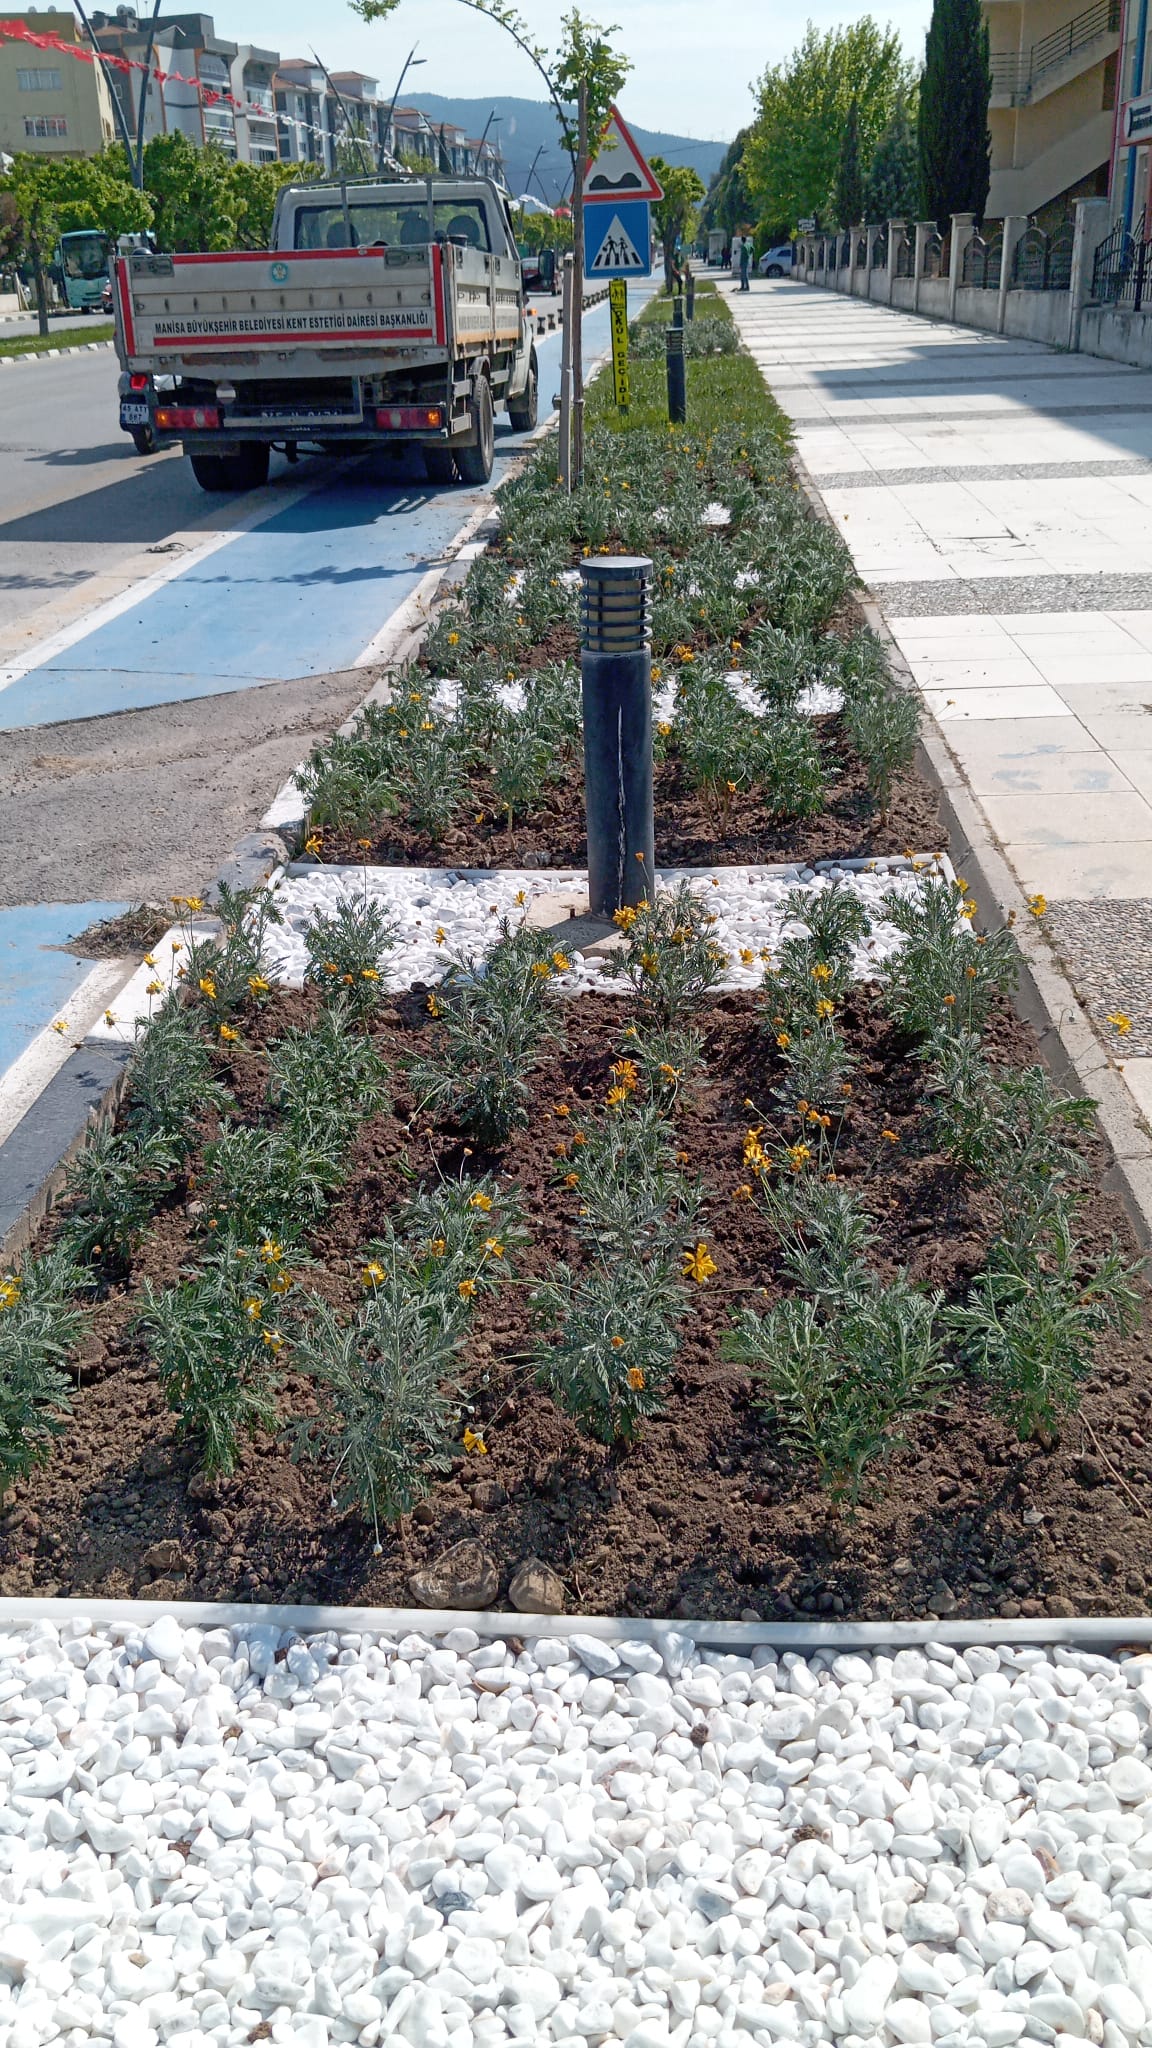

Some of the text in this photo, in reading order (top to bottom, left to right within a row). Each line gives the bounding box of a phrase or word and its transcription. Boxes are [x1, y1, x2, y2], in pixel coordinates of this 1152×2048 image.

[155, 319, 186, 334] MANİSA
[187, 317, 238, 335] BÜYÜKŞEHİR
[239, 315, 286, 331] BELEDİYESİ
[286, 317, 307, 329] KENT
[346, 311, 378, 327] DAİRESİ
[380, 310, 428, 328] BAŞKANLIĞI
